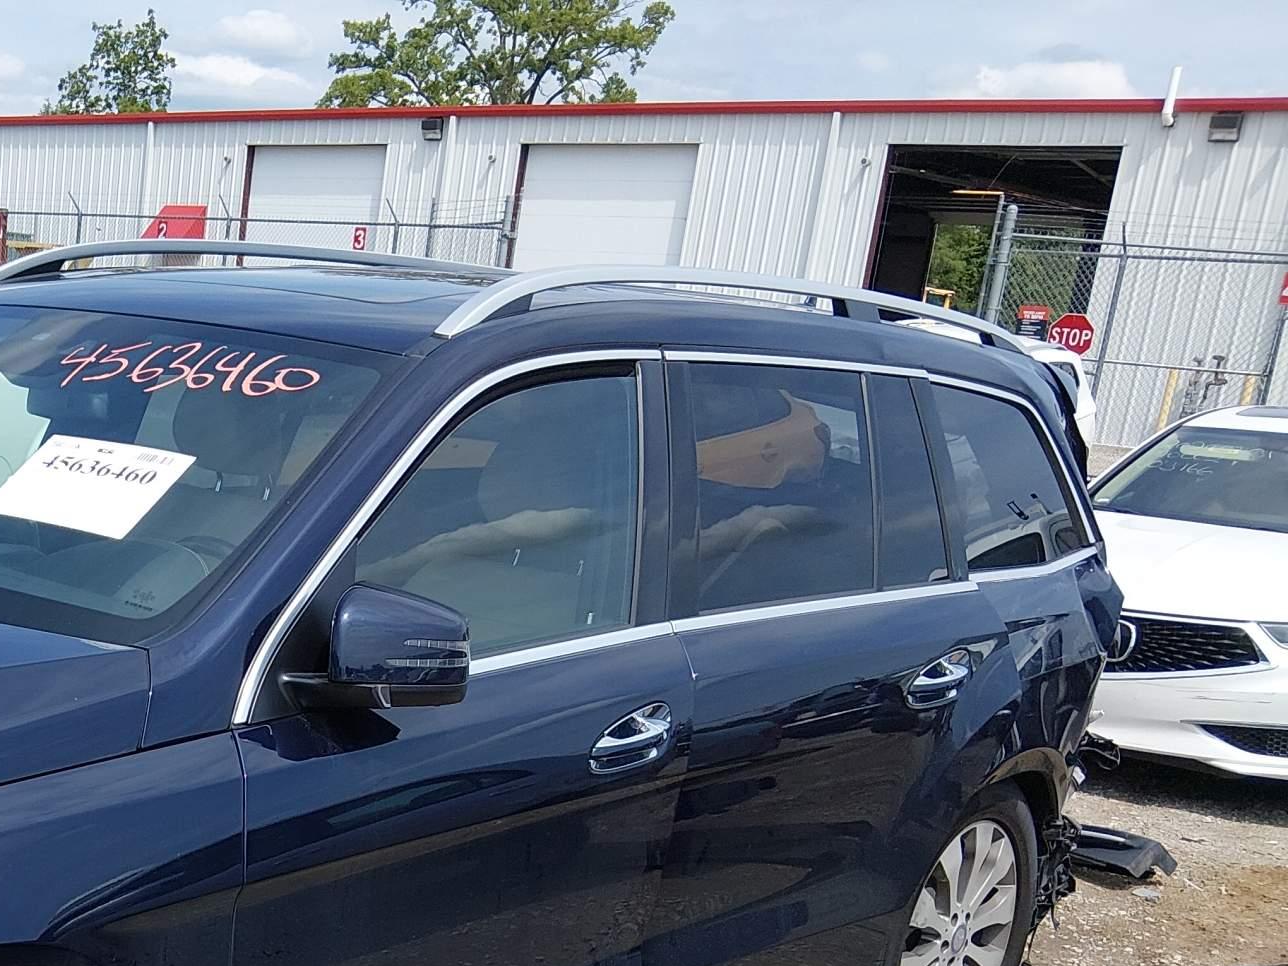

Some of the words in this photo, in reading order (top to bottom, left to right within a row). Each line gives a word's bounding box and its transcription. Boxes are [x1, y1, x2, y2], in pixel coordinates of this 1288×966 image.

[158, 223, 168, 239] 2
[353, 228, 366, 250] 3
[1050, 327, 1092, 347] STOP
[60, 341, 321, 397] 45636460
[42, 455, 158, 485] 45636460
